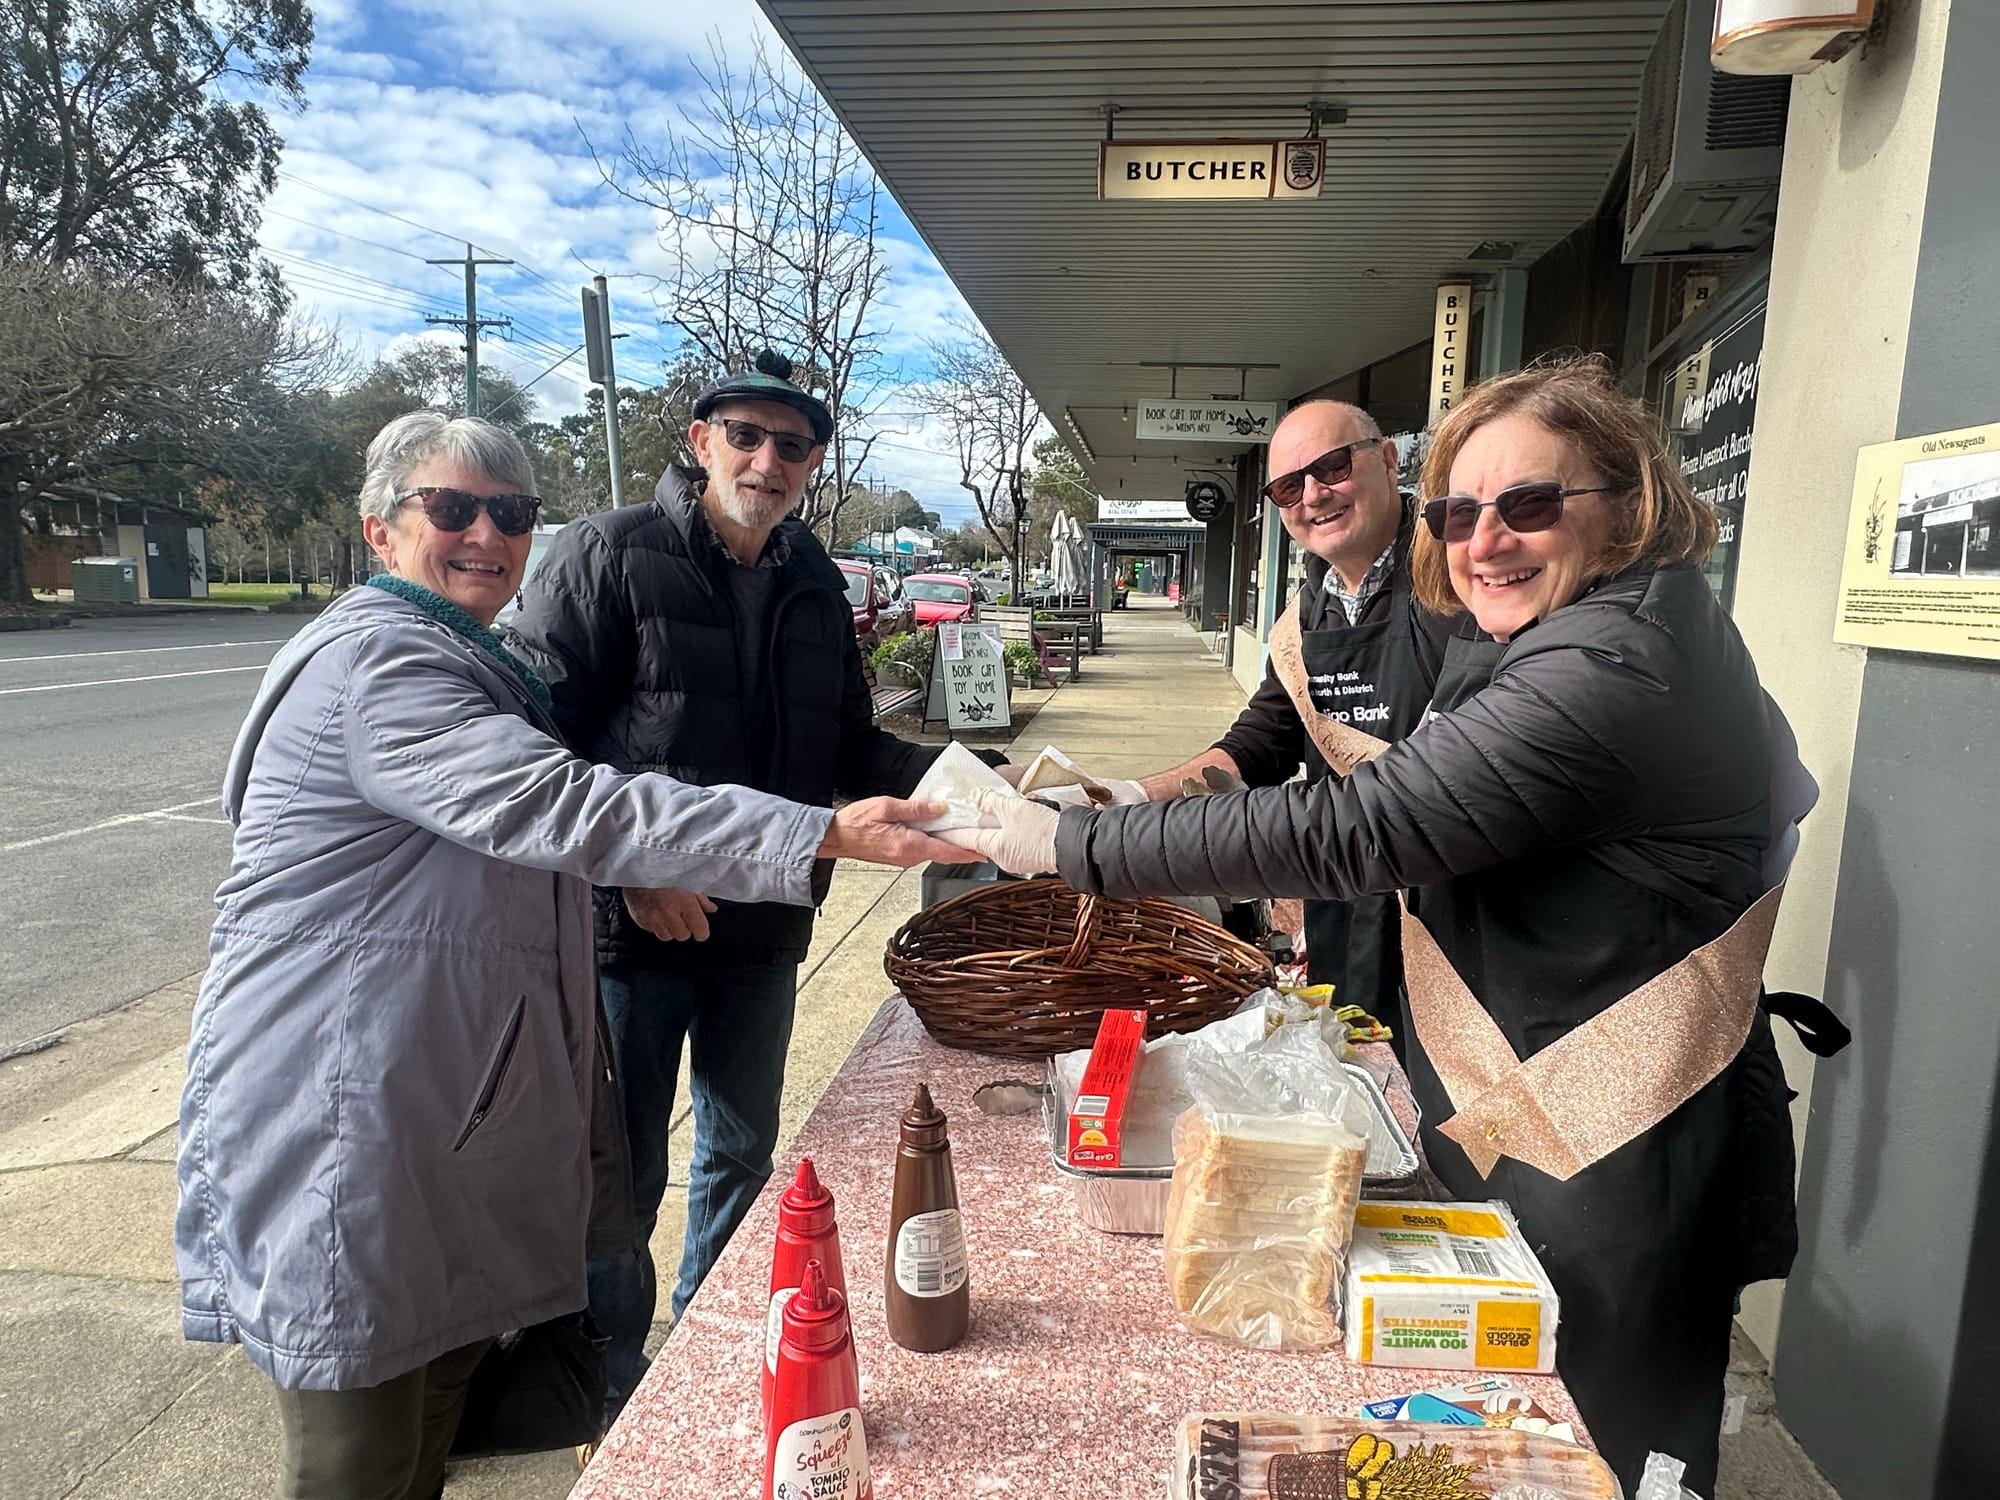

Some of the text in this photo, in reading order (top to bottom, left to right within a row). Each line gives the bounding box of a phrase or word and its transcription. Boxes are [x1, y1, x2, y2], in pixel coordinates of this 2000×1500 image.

[1126, 161, 1267, 180] BUTCHER
[1439, 295, 1458, 410] BUTCHER
[1145, 407, 1226, 421] BOOK GIFT TOY HOME
[1699, 436, 1728, 471] Livestock
[1729, 426, 1752, 459] Butch
[1922, 434, 1986, 454] Old Newsagents
[952, 664, 997, 678] BOOK GIFT
[1336, 670, 1359, 682] Bank
[953, 679, 997, 695] TOY HOME
[1334, 688, 1341, 696] &
[1342, 683, 1374, 696] District
[1353, 702, 1390, 722] Bank
[1382, 1317, 1468, 1330] SERVIETTES
[1392, 1329, 1460, 1338] EMBOSSED
[1486, 1331, 1516, 1340] GOLD
[1382, 1337, 1469, 1350] 100 WHITE
[1487, 1338, 1519, 1346] BLACK
[799, 1421, 839, 1437] community
[796, 1426, 853, 1472] Squeeze
[813, 1439, 822, 1452] A
[830, 1454, 842, 1469] of
[1200, 1418, 1240, 1500] FRES
[810, 1467, 850, 1488] TOMATO
[813, 1479, 849, 1498] SAUCE
